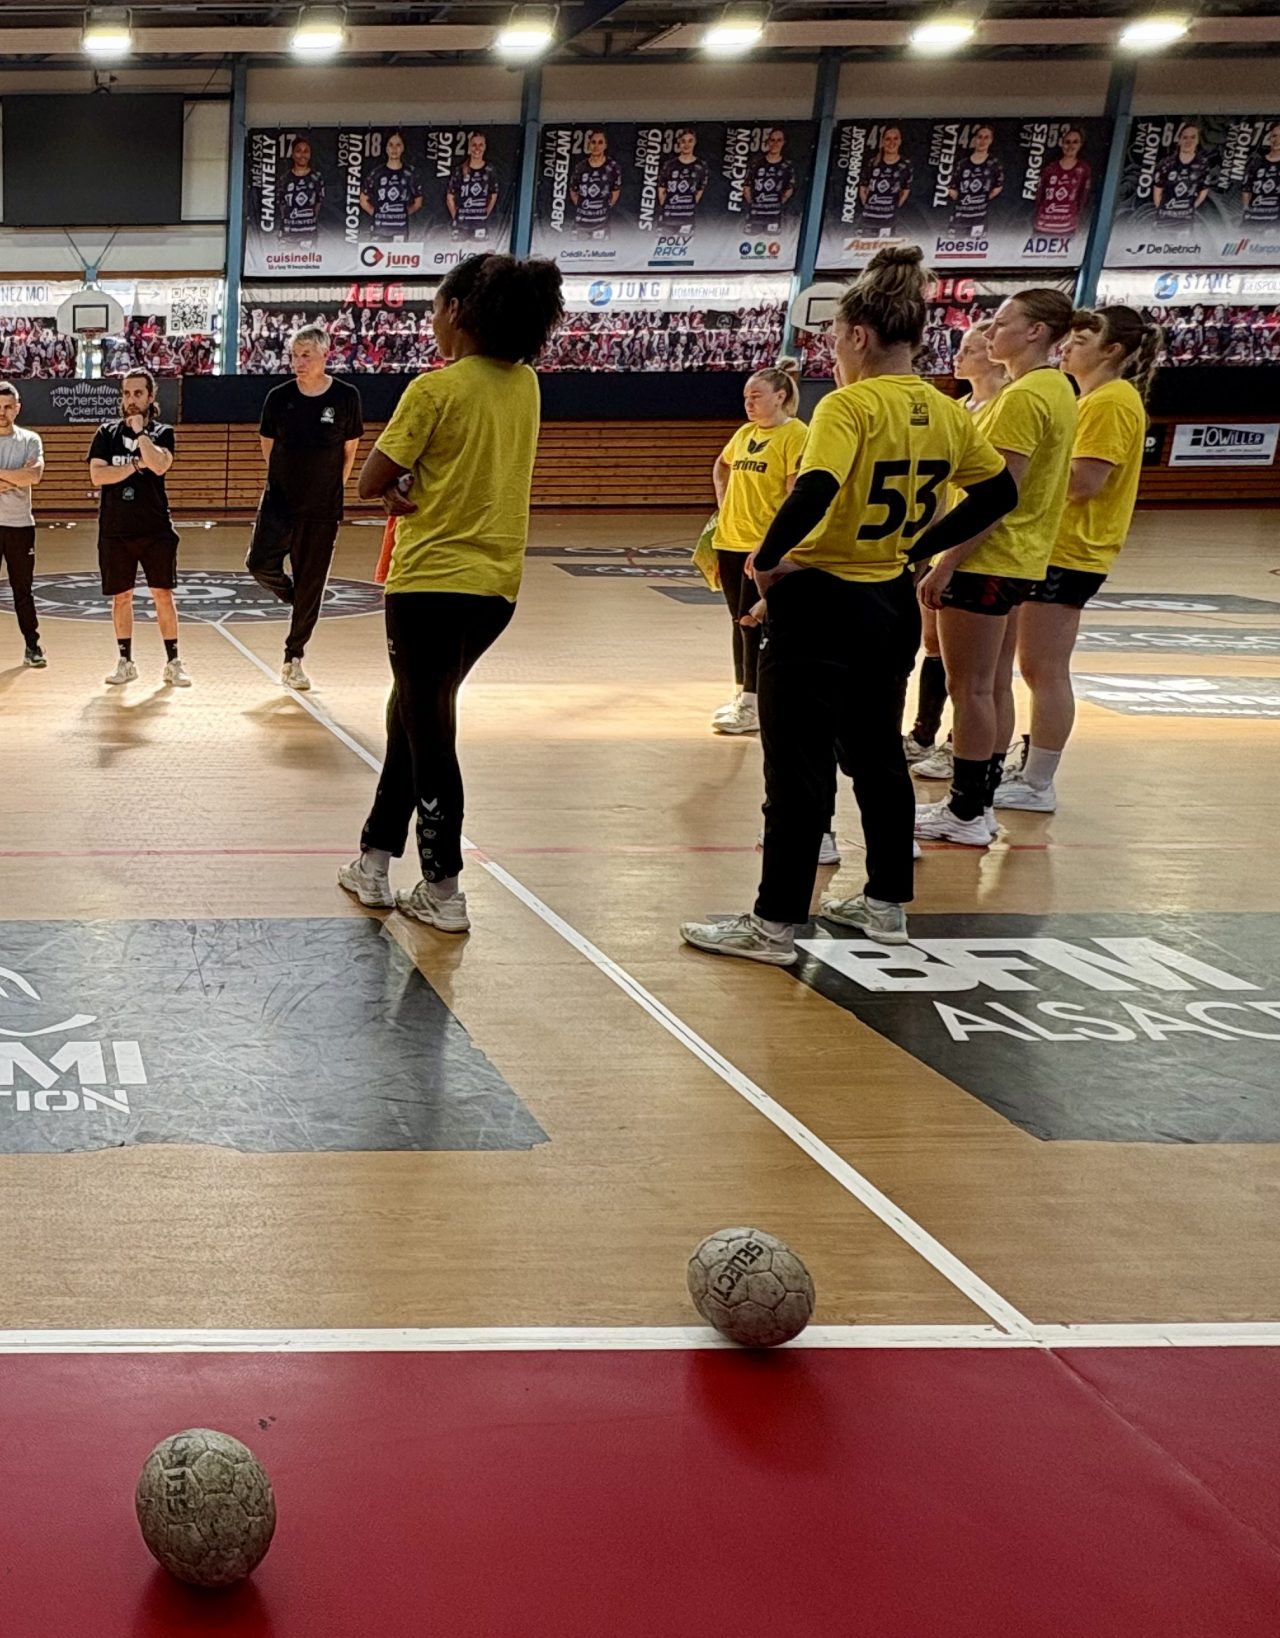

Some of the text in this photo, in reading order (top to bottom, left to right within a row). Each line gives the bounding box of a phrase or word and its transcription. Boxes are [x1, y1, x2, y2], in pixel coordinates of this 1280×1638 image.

[278, 133, 297, 159] 17
[337, 133, 350, 168] YOSR
[363, 132, 383, 158] 18
[426, 131, 439, 160] LISA
[436, 131, 453, 178] VLUG
[543, 130, 557, 178] DALILA
[634, 128, 649, 169] NORA
[722, 127, 738, 179] ALBANE
[837, 125, 853, 169] OLIVIA
[928, 123, 945, 166] EMMA
[1132, 121, 1149, 154] LINA
[1218, 123, 1241, 190] MARGAUX
[1230, 121, 1254, 181] IMHOF
[251, 133, 264, 188] MÉLISSA
[550, 129, 572, 233] ABDESSELAM
[638, 128, 663, 232] SNEDKERUD
[728, 128, 751, 212] FRACHON
[841, 125, 868, 224] ROUGE-CARRASSAT
[932, 123, 960, 208] TUCCELLA
[1022, 122, 1048, 200] FARGUES
[1136, 122, 1162, 199] COLINOT
[260, 134, 277, 233] CHANTELLY
[345, 132, 363, 244] MOSTEFAOUI
[266, 251, 322, 264] cuisinella
[386, 251, 421, 268] jung
[653, 246, 688, 257] RACK
[657, 236, 693, 247] POLY
[936, 237, 989, 253] koesio
[1023, 237, 1071, 253] ADEX
[1162, 244, 1202, 255] Dietrich
[25, 286, 49, 302] MOI
[616, 281, 661, 299] JUNG
[732, 457, 768, 474] erima
[856, 459, 952, 541] 53
[794, 937, 1265, 993] BFM
[932, 1000, 1280, 1042] ALSAC
[712, 1240, 764, 1302] SELECT
